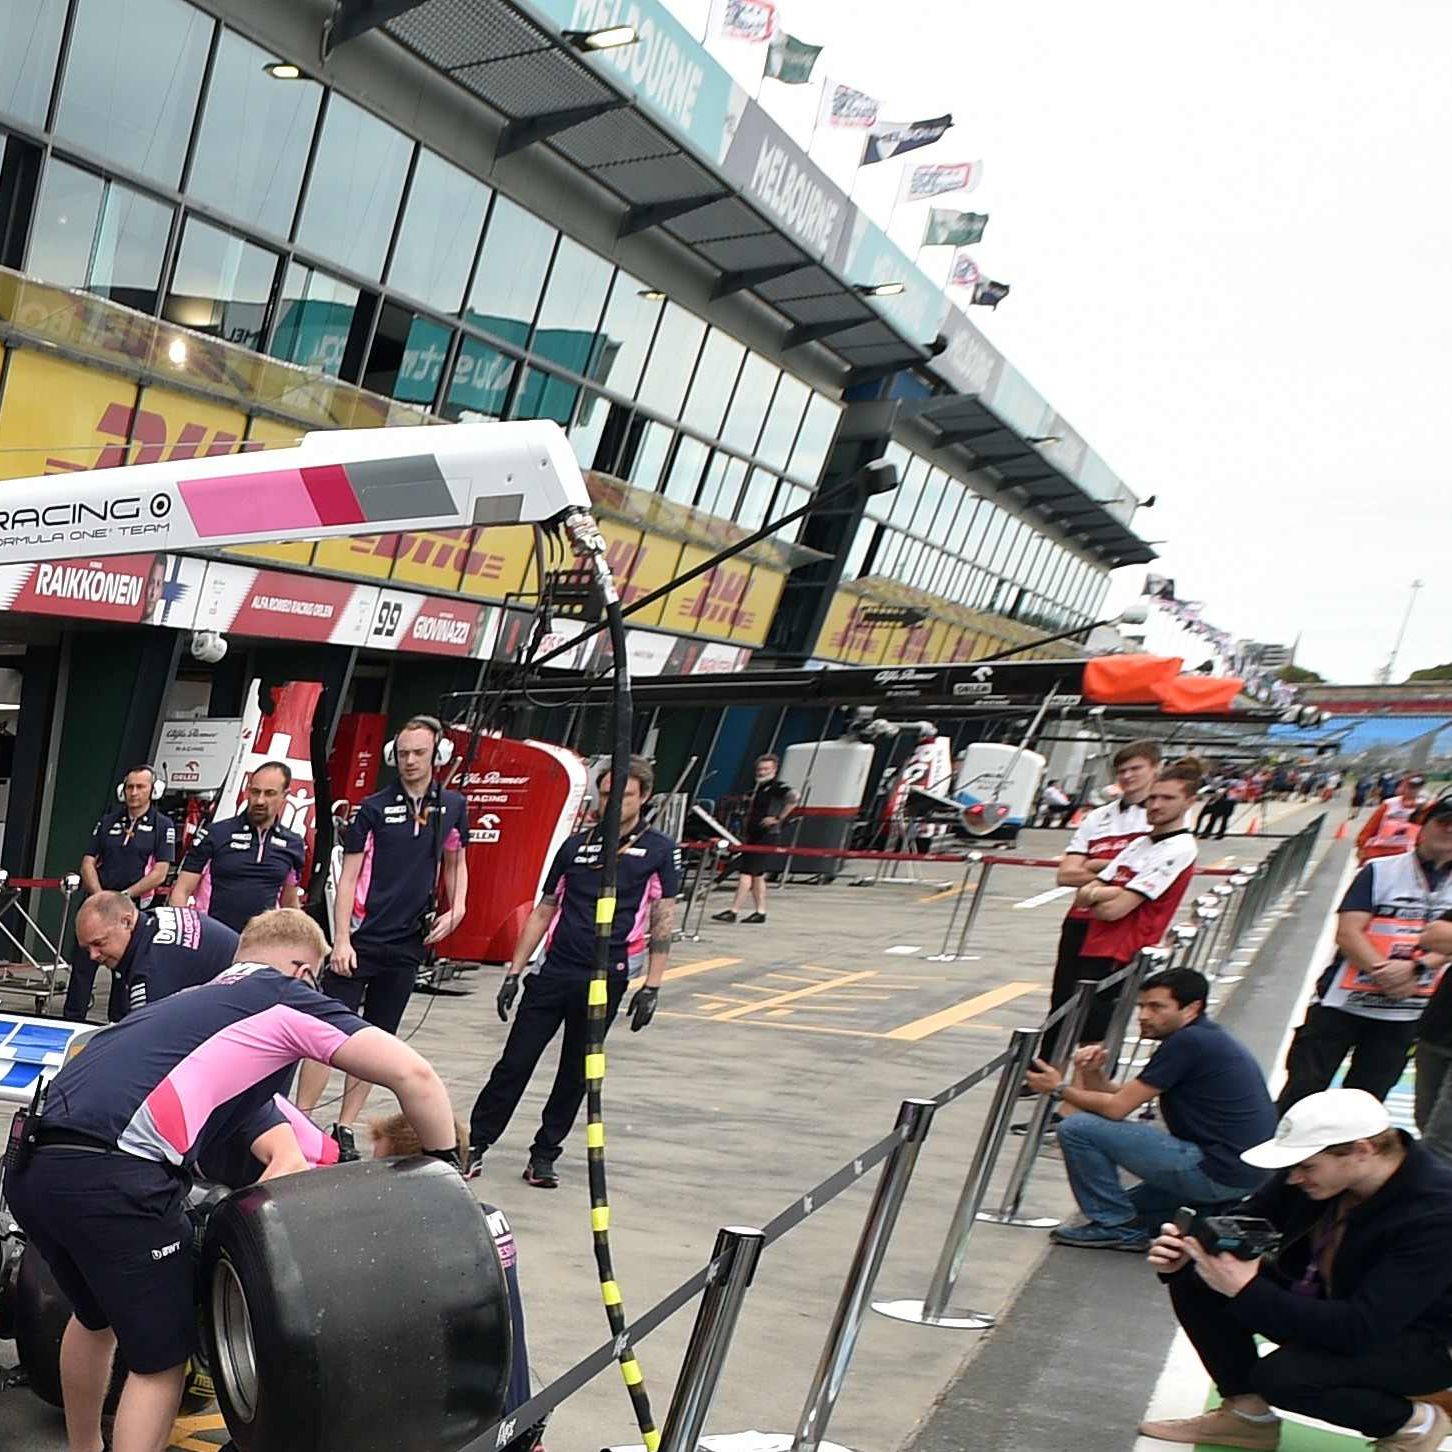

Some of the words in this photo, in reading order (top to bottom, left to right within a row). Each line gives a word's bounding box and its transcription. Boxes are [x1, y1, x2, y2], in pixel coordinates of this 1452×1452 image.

[749, 133, 840, 252] MELBOURNE
[117, 523, 170, 538] TEAM
[373, 602, 402, 636] 99
[412, 615, 470, 645] GIOVINAZZI
